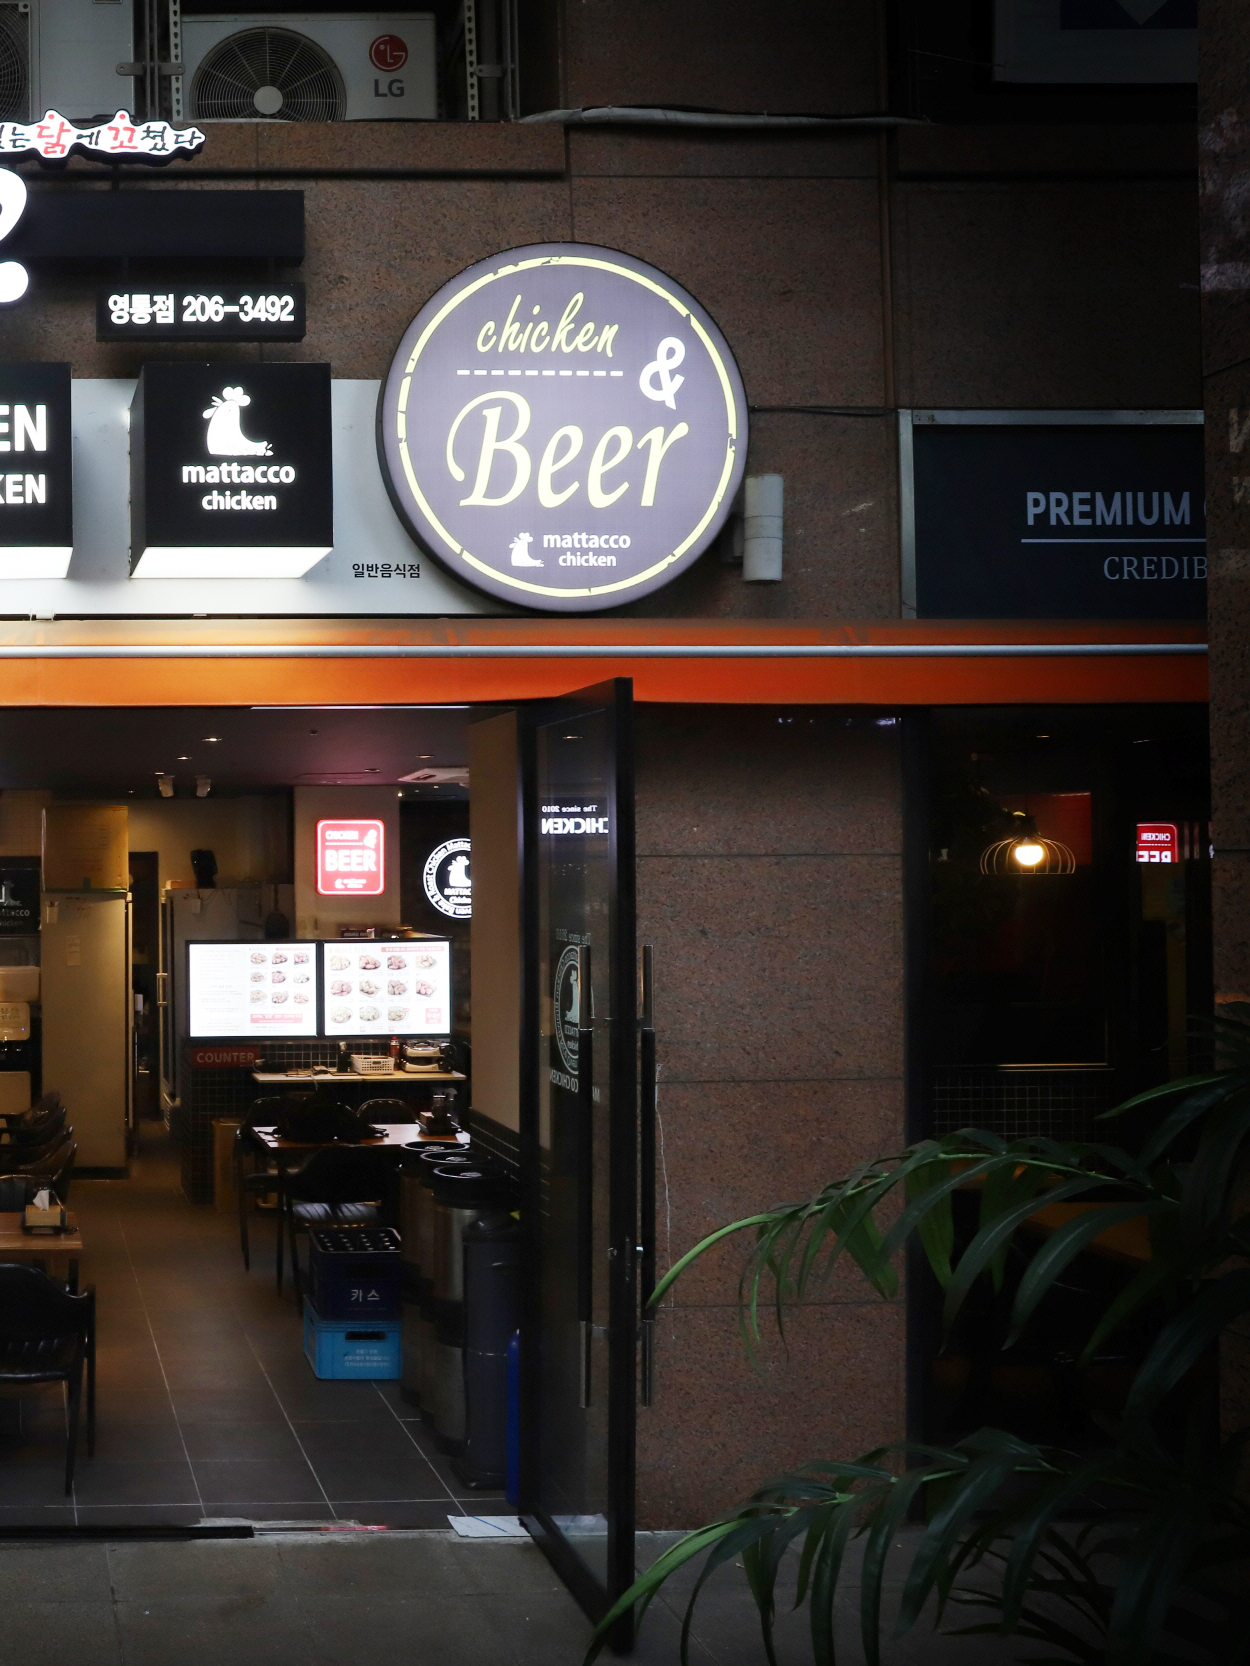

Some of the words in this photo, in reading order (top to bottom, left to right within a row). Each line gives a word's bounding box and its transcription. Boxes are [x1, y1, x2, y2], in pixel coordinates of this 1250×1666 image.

[373, 79, 405, 98] LG
[108, 294, 175, 324] 영통점
[182, 294, 295, 323] 206-3492
[476, 291, 620, 358] chicken
[639, 336, 686, 410] &
[446, 390, 689, 508] Beer
[181, 461, 296, 484] mattacco
[201, 490, 278, 511] chicken
[1026, 491, 1191, 526] PREMIUM
[542, 531, 631, 550] mattacco
[352, 563, 420, 579] 일반음식점
[557, 552, 617, 568] chicken
[1103, 556, 1208, 580] CREDIB
[325, 849, 378, 872] BEER
[196, 1052, 255, 1063] COUNTER
[350, 1289, 380, 1302] 카스
